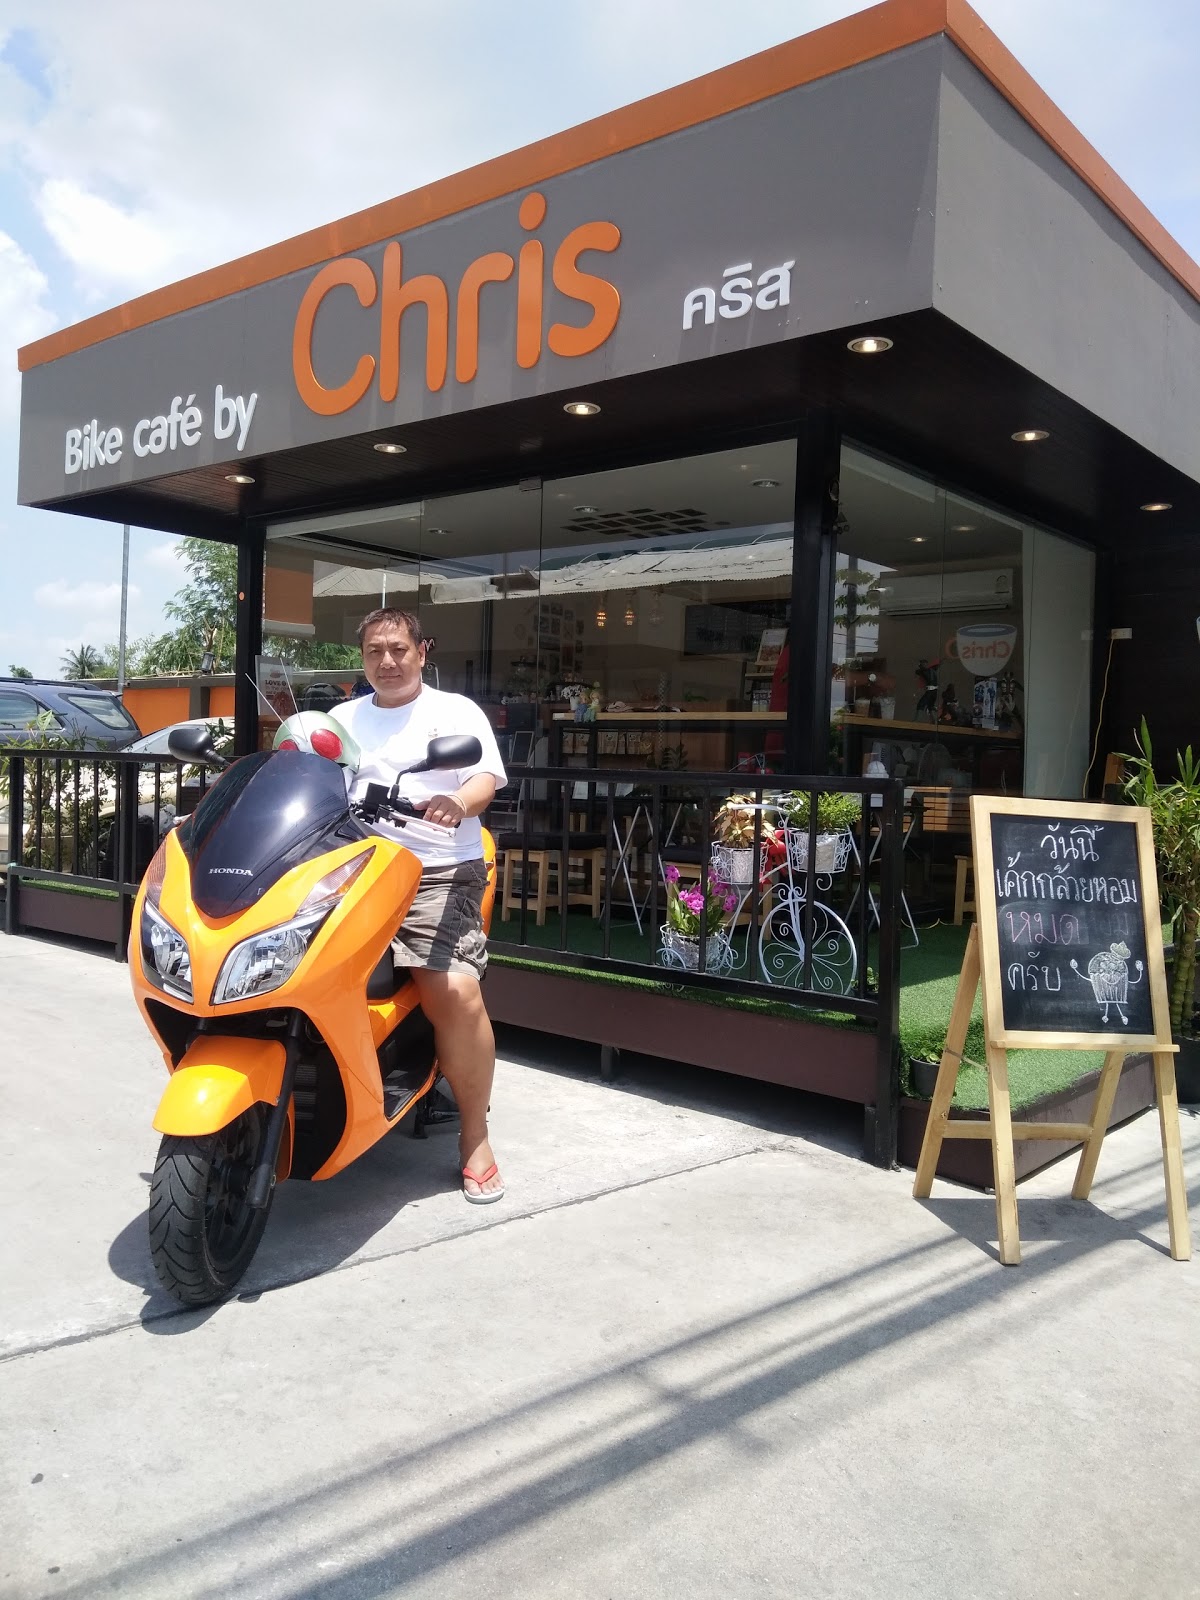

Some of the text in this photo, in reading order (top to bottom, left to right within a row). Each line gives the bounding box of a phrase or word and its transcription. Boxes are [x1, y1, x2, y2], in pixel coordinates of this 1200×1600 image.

[293, 192, 621, 415] Chris
[682, 260, 795, 330] คริส
[65, 384, 258, 475] Bike café by
[1040, 822, 1104, 861] วันนี้
[208, 867, 253, 876] HONDA
[1005, 911, 1080, 945] หมด
[1007, 951, 1061, 991] ครับ
